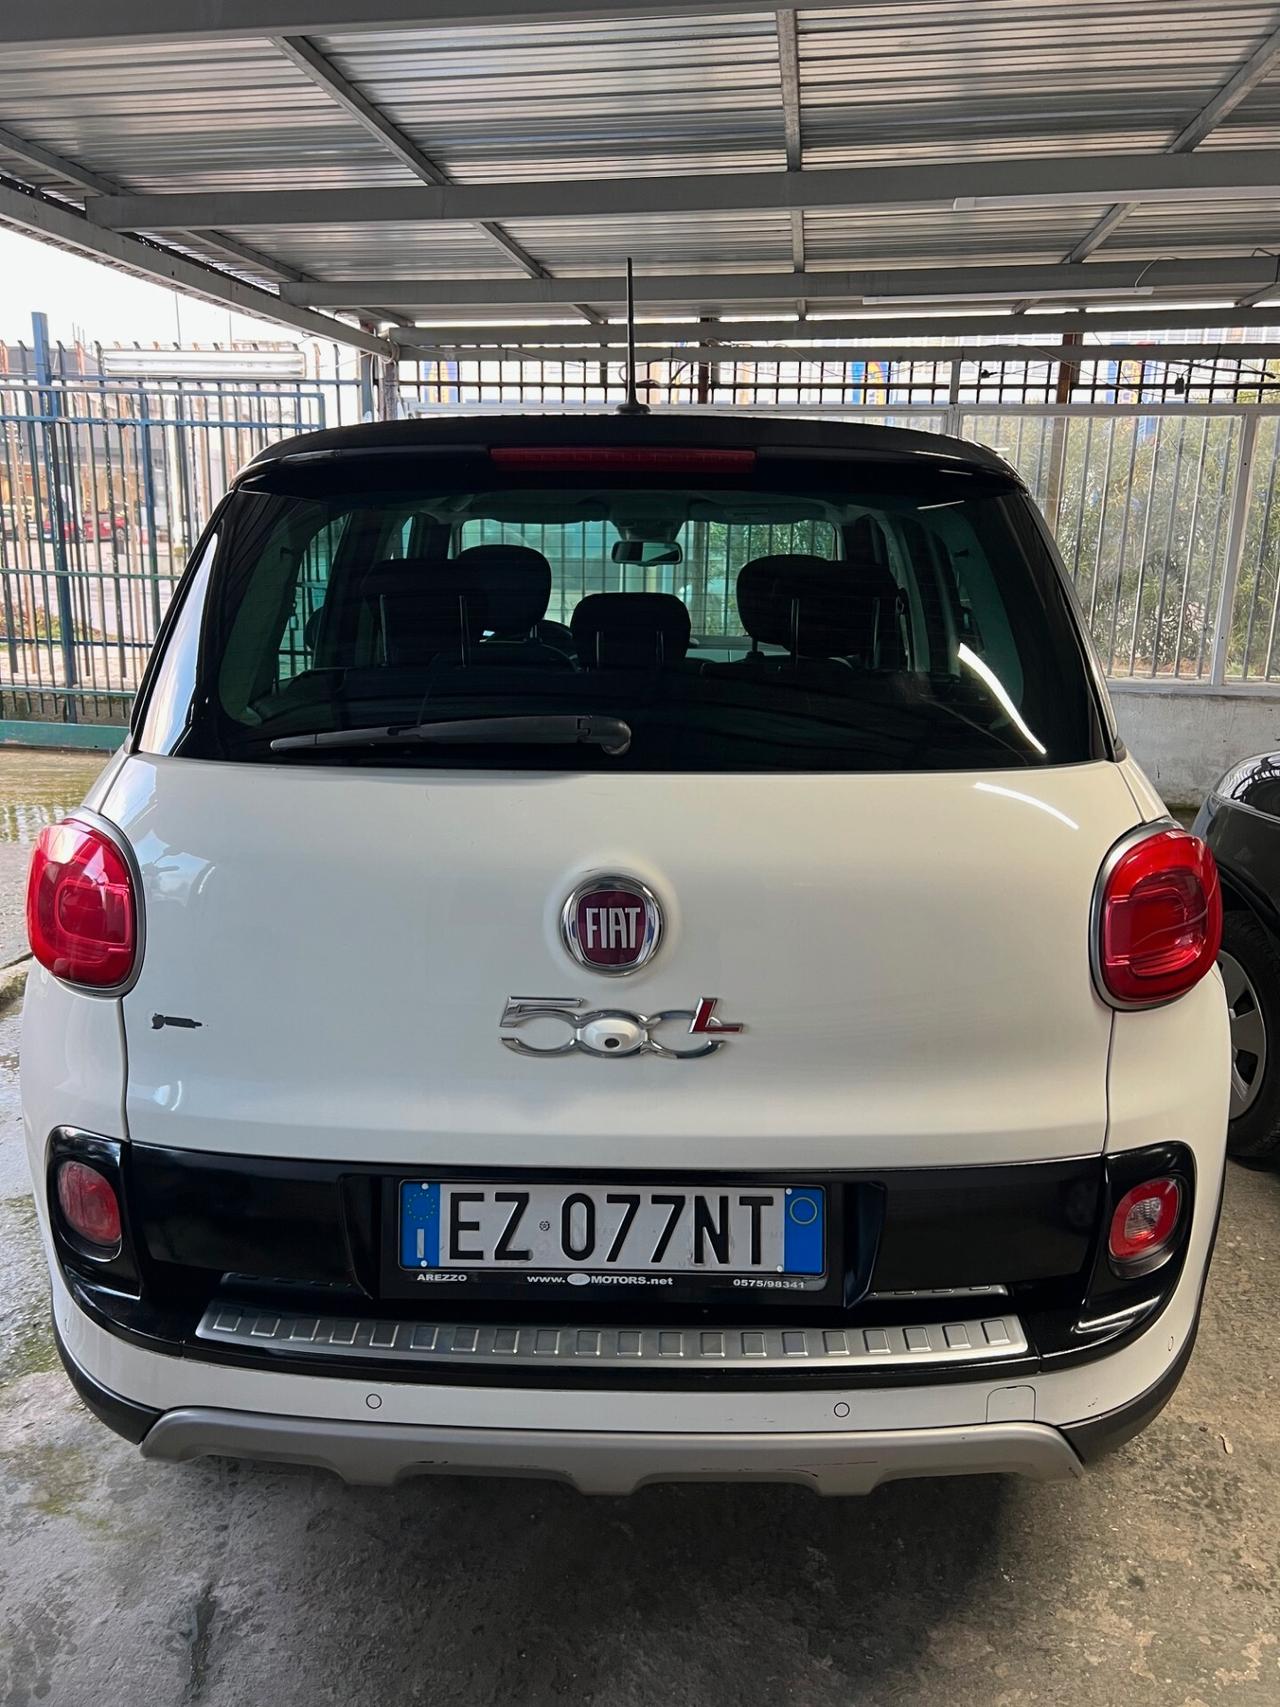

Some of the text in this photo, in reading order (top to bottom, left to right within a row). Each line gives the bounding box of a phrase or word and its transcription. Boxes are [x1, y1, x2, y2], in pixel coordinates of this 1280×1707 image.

[585, 908, 640, 949] FIAT
[416, 1273, 468, 1282] AREZZO
[732, 1279, 806, 1289] 0575/98341
